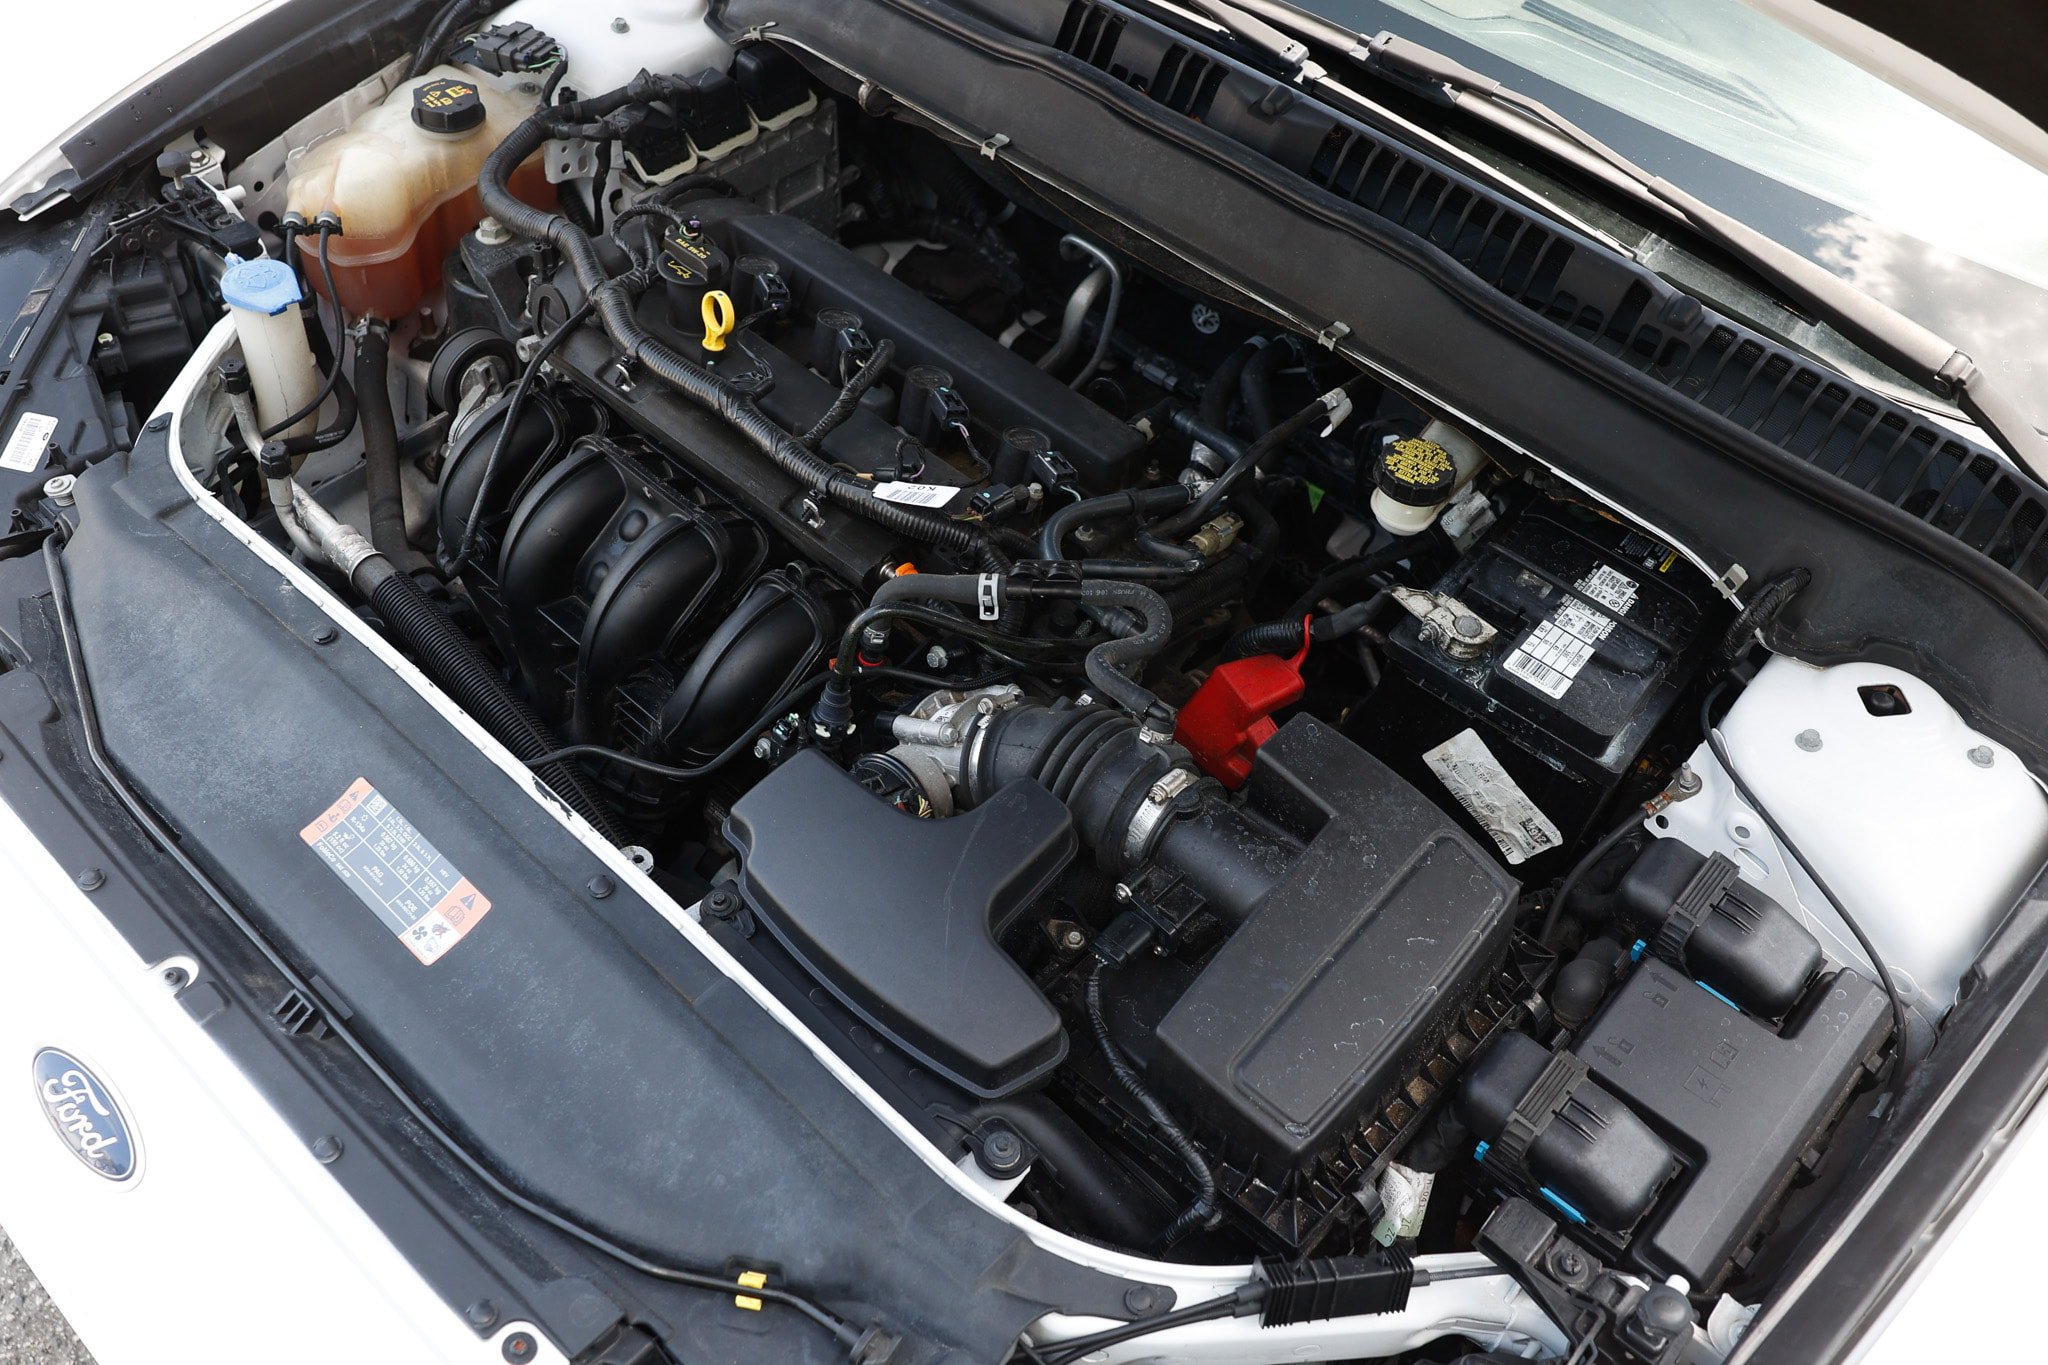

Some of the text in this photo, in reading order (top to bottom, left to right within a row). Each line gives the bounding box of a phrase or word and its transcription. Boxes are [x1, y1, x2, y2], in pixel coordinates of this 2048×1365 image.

[675, 237, 707, 259] SAE 5W-20
[44, 1069, 118, 1157] Ford
[1385, 1228, 1395, 1242] ZC
